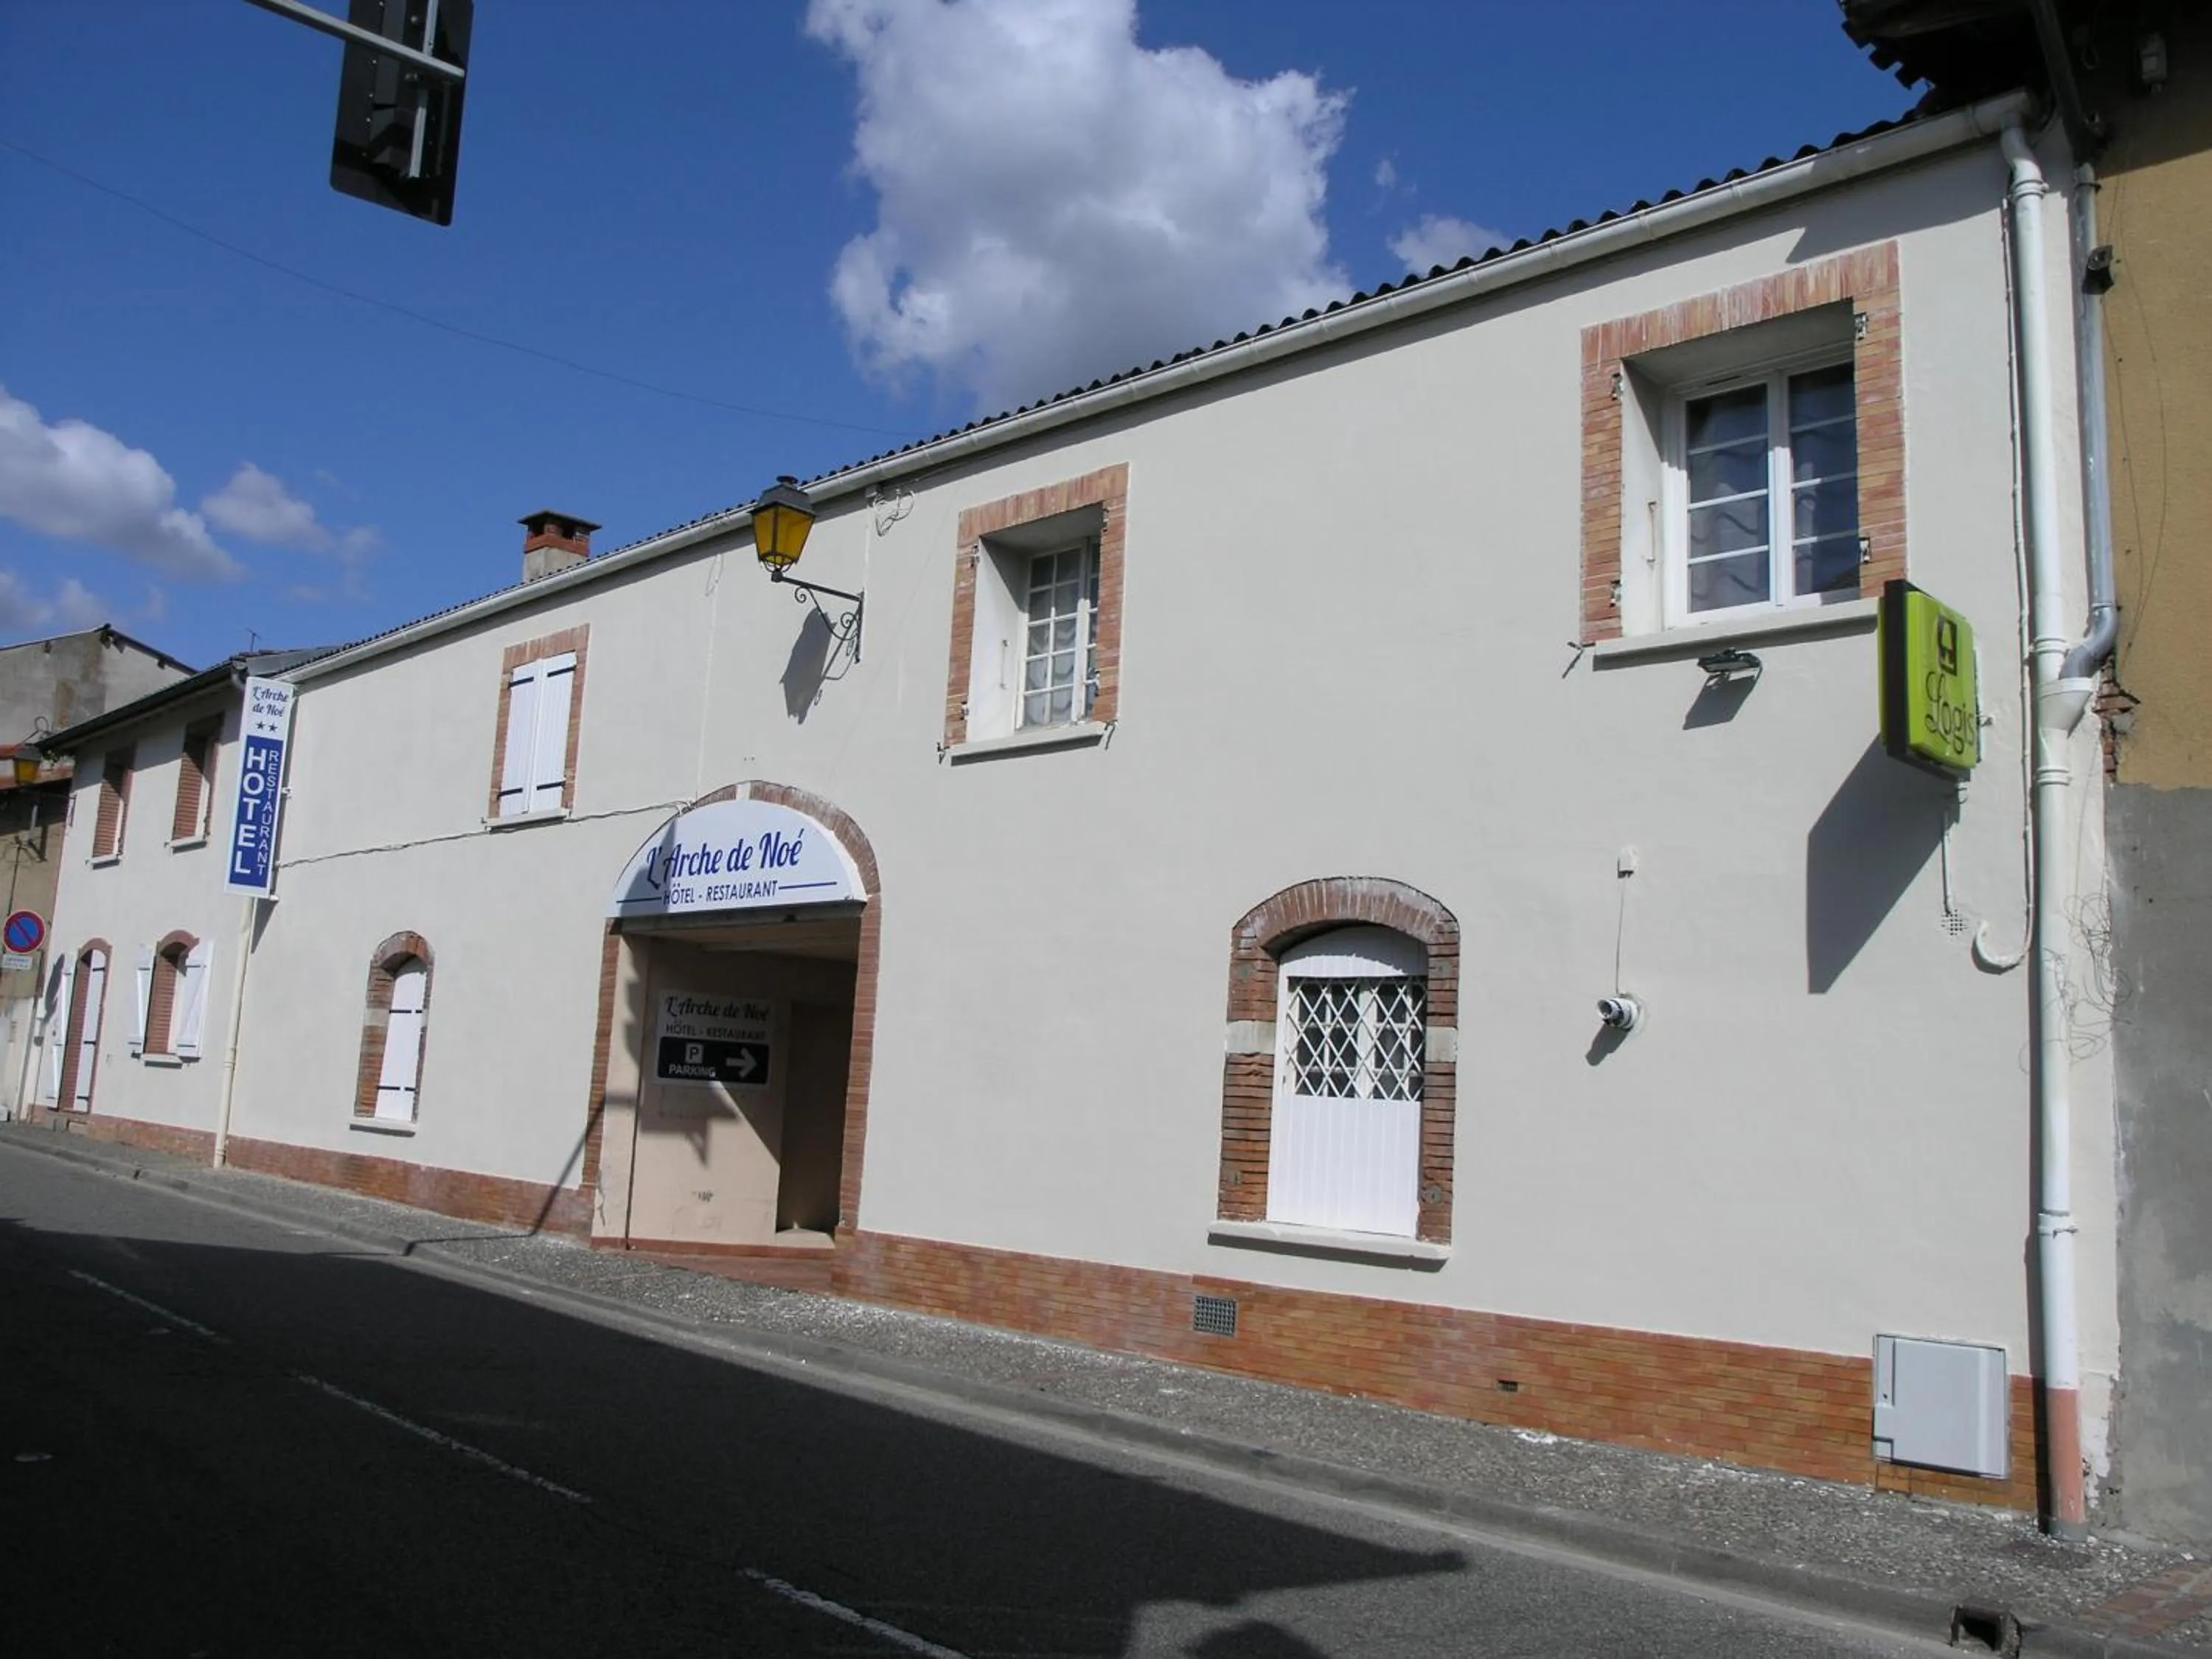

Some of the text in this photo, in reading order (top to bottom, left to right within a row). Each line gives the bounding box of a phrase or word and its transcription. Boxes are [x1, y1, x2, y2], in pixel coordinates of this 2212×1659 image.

[252, 686, 289, 702] L'Arche
[253, 703, 264, 713] de
[1925, 672, 1975, 754] Logis
[235, 747, 265, 874] HOTEL
[257, 749, 279, 876] RESTAURANT
[647, 828, 804, 890] L'Arche de Noé
[706, 880, 778, 901] RESTAURANT
[667, 996, 770, 1022] L'Arche de Noé
[706, 1026, 767, 1040] RESTAURANT
[689, 1047, 699, 1060] P
[669, 1064, 717, 1077] PARKING
